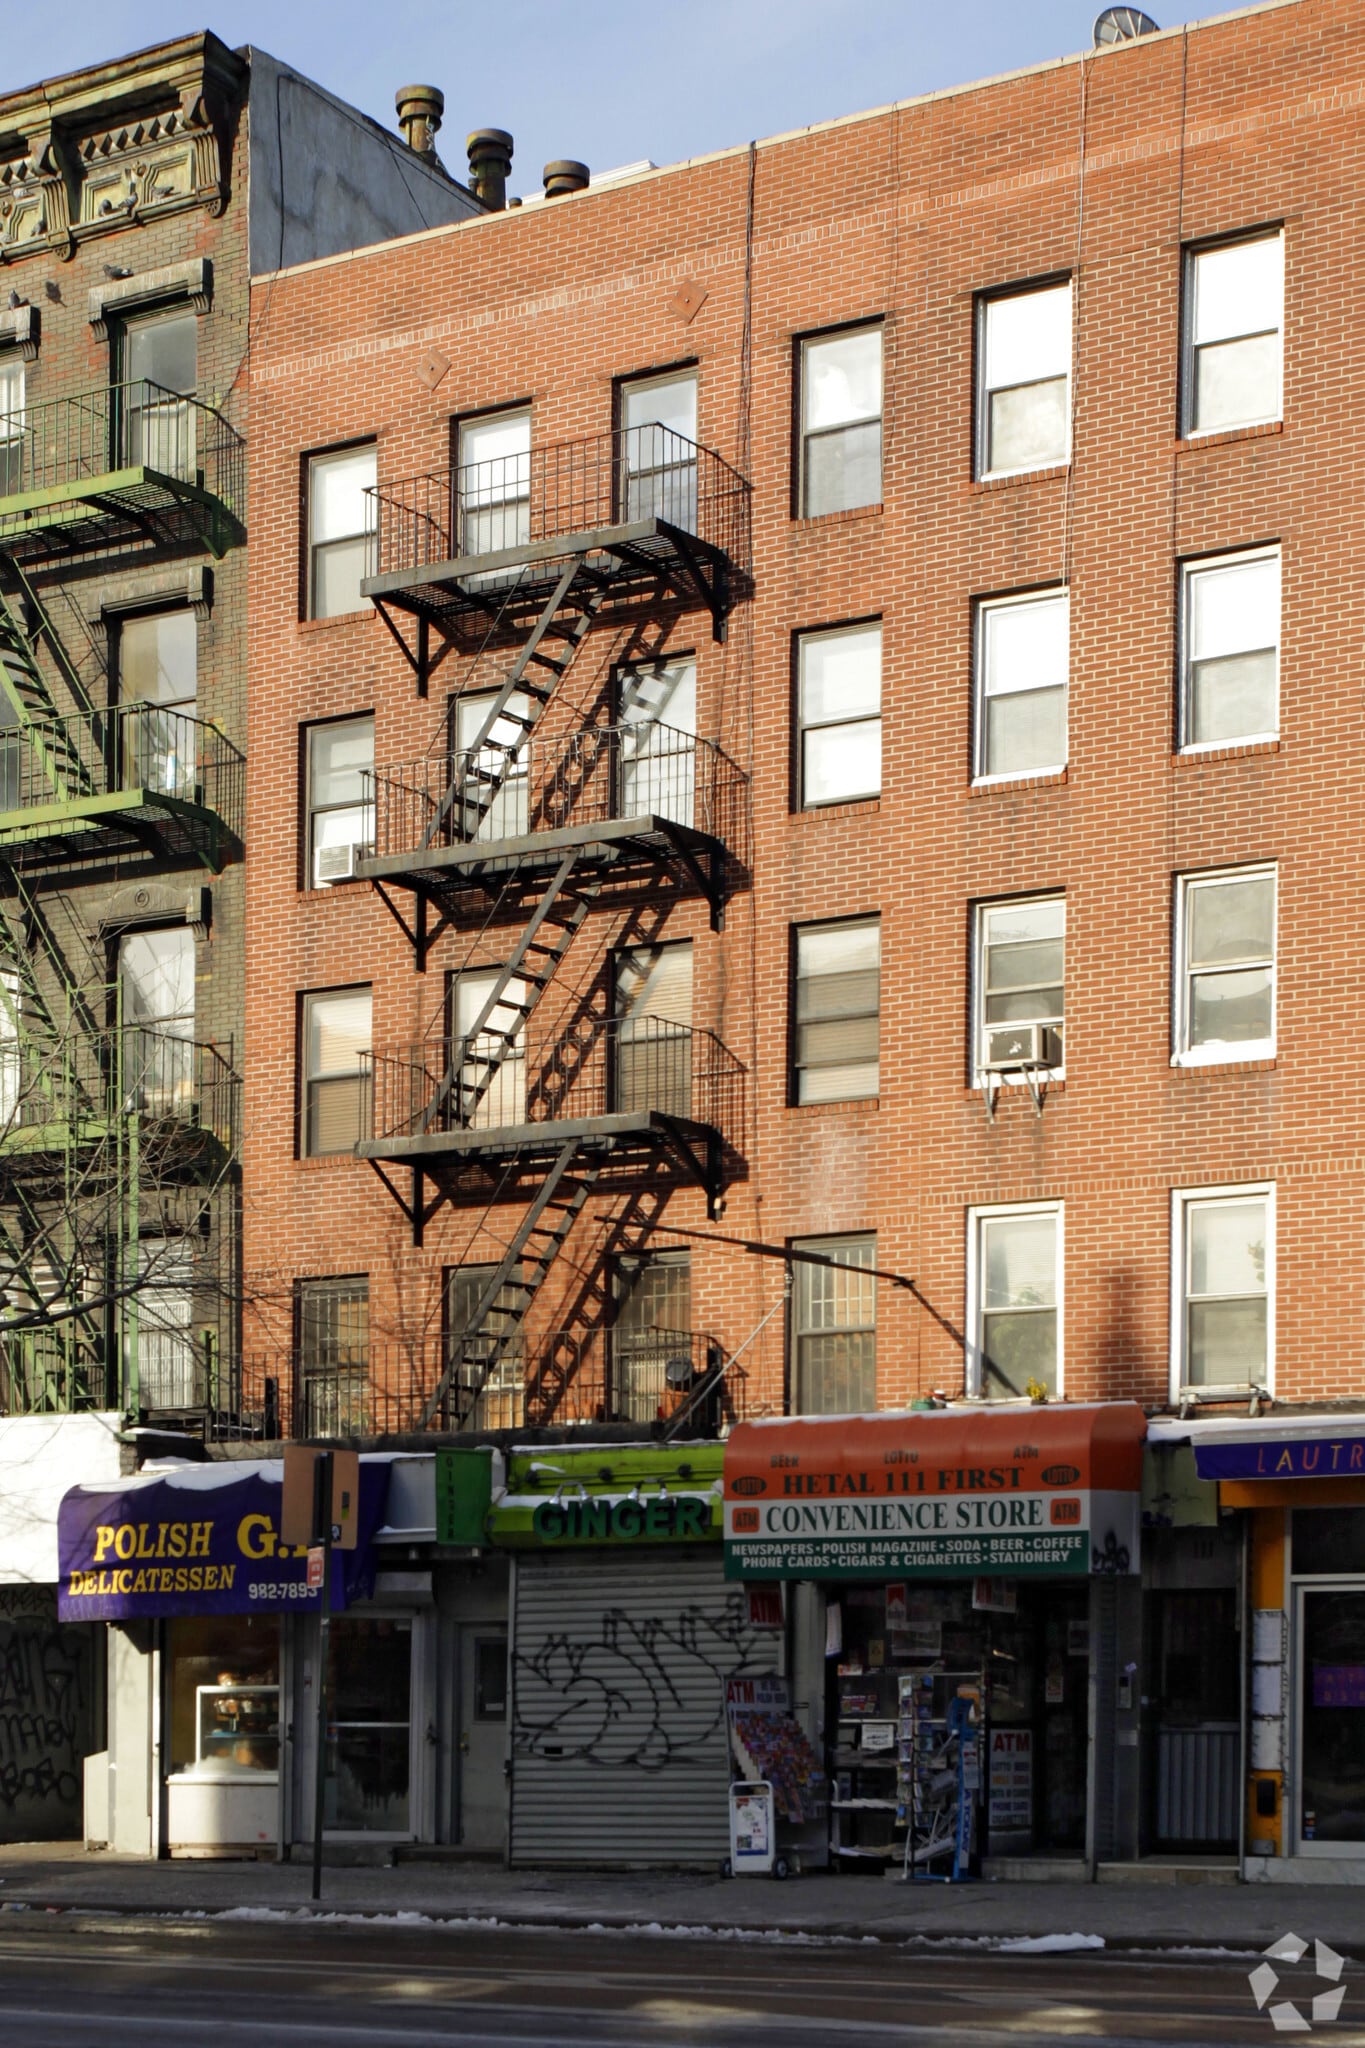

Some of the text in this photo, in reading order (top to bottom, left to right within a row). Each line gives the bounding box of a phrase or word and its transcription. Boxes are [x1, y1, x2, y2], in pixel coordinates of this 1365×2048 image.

[770, 1455, 799, 1468] BEER
[884, 1450, 919, 1464] LOTTO
[1013, 1445, 1039, 1459] ATM
[783, 1467, 1024, 1494] HETAL 111 FIRST
[533, 1497, 712, 1539] GINGER
[735, 1511, 757, 1528] ATM
[767, 1499, 1043, 1532] CONVENIENCE STORE
[1054, 1503, 1078, 1521] ATM
[93, 1521, 214, 1562] POLISH
[732, 1536, 1082, 1556] NEWSPAPERS POLISH MAGAZINE SODA BEER COFFEE
[742, 1550, 1070, 1568] PHONE CARDS CIGARS & CIGARETTES STATIONERY
[68, 1564, 237, 1596] DELICATESSEN
[751, 1593, 781, 1623] ATM
[727, 1680, 755, 1704] ATM
[993, 1733, 1029, 1752] ATM
